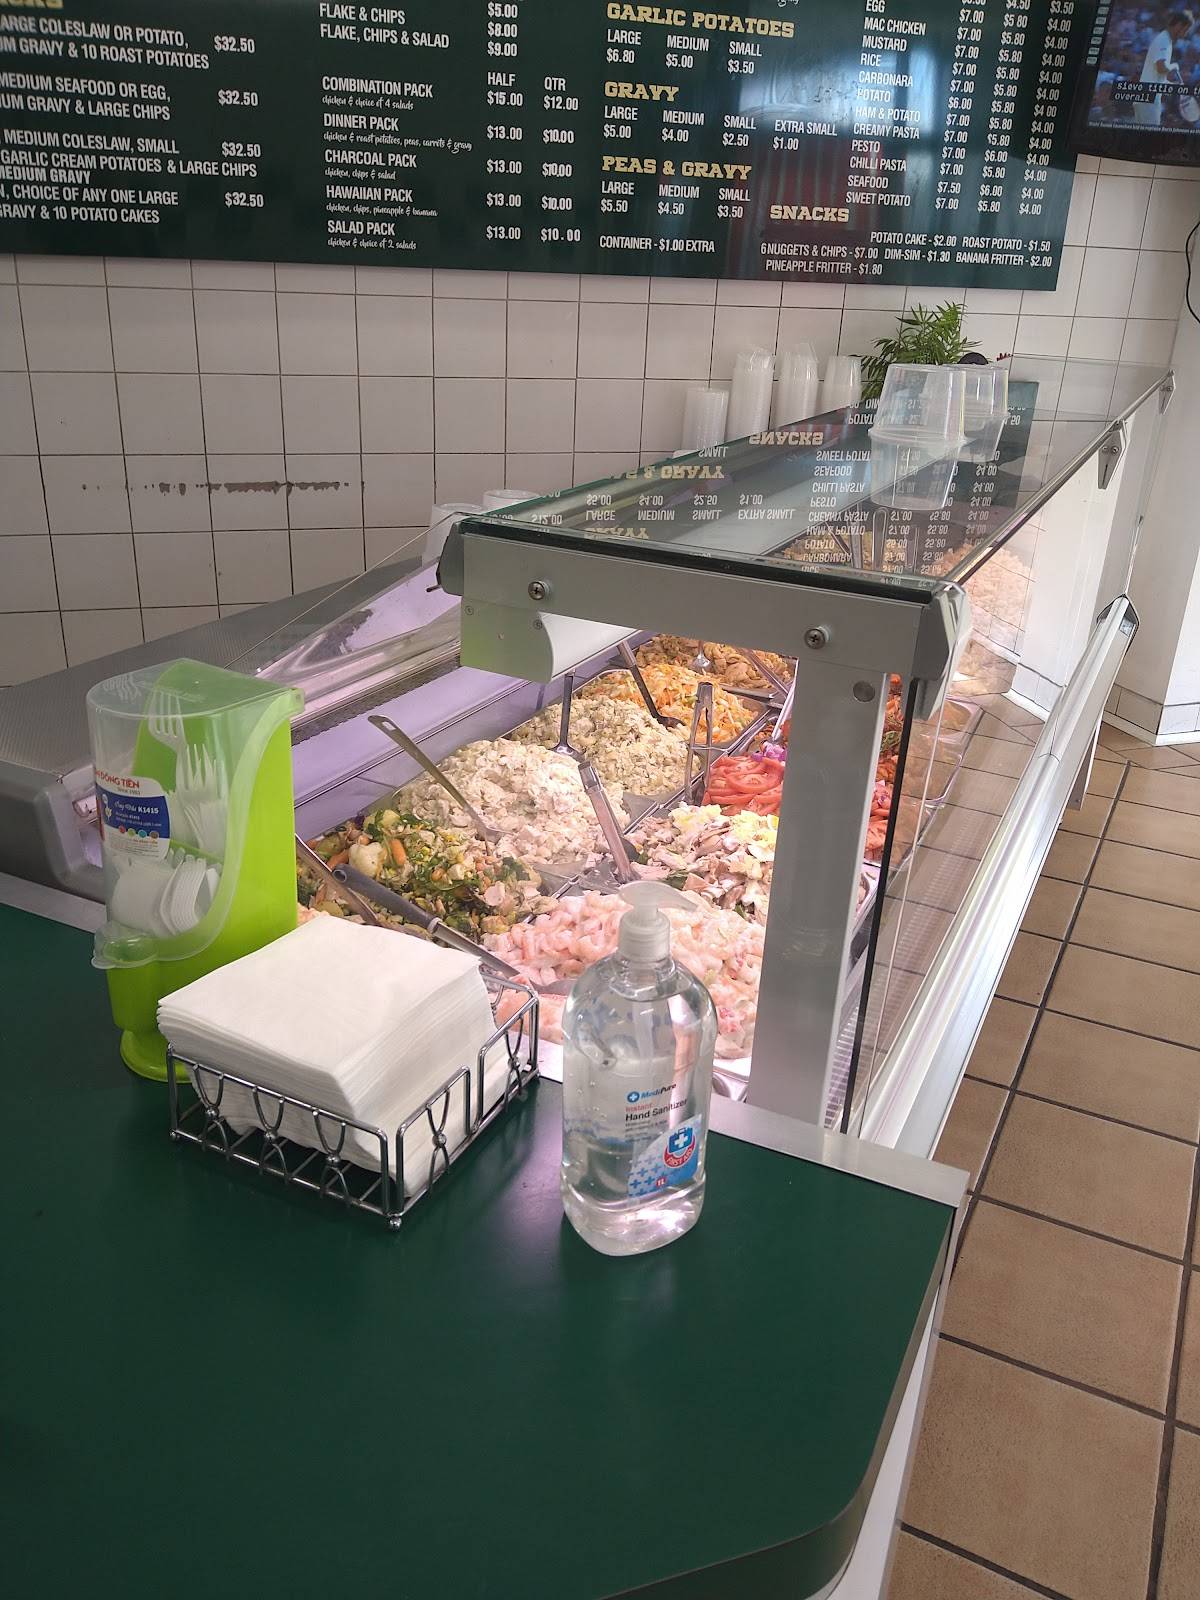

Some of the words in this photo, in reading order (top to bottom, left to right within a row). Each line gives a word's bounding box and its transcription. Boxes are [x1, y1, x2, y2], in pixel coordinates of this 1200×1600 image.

[319, 3, 356, 20] FLAKE
[371, 8, 405, 25] CHIPS
[487, 2, 518, 18] $5.00
[1050, 0, 1074, 14] $3.50
[607, 2, 686, 26] GARLIC
[691, 11, 795, 38] POTATOES
[959, 9, 984, 24] $7.00
[1047, 18, 1071, 32] $4.00
[39, 18, 110, 40] COLESLAW
[114, 25, 132, 41] OR
[136, 30, 189, 49] POTATO,
[487, 22, 518, 38] $8.00
[864, 17, 886, 32] MAC
[887, 20, 926, 36] CHICKEN
[214, 35, 255, 54] $32.50
[320, 24, 360, 43] FLAKE,
[363, 27, 398, 44] CHIPS
[412, 32, 449, 49] SALAD
[607, 28, 641, 46] LARGE
[667, 34, 709, 52] MEDIUM
[729, 41, 762, 57] SMALL
[862, 35, 907, 51] MUSTARD
[1000, 31, 1025, 45] $5.80
[19, 37, 63, 56] GRAVY
[81, 44, 97, 60] 10
[100, 46, 142, 64] ROAST
[147, 50, 209, 69] POTATOES
[487, 41, 518, 57] $9.00
[606, 48, 635, 65] $6.80
[665, 53, 694, 69] $5.00
[727, 58, 755, 75] $3.50
[860, 53, 881, 67] RICE
[55, 77, 116, 97] SEAFOOD
[119, 82, 137, 99] OR
[140, 84, 171, 102] EGG,
[322, 76, 401, 97] COMBINATION
[404, 82, 433, 98] PACK
[487, 72, 515, 87] HALF
[544, 77, 566, 92] QTR
[218, 89, 258, 107] $32.50
[604, 80, 679, 102] GRAVY
[27, 96, 70, 113] GRAVY
[88, 102, 131, 119] LARGE
[133, 105, 170, 120] CHIPS
[487, 91, 523, 107] $15.00
[543, 95, 579, 111] $12.00
[948, 96, 973, 111] $6.00
[324, 113, 367, 130] DINNER
[370, 116, 399, 132] PACK
[604, 105, 638, 121] LARGE
[663, 110, 704, 126] MEDIUM
[724, 114, 756, 130] SMALL
[487, 125, 523, 140] $13.00
[775, 119, 805, 134] EXTRA
[807, 121, 838, 137] SMALL
[853, 123, 891, 138] CREAMY
[893, 126, 920, 140] PASTA
[4, 129, 59, 147] MEDIUM
[62, 133, 134, 153] COLESLAW,
[137, 138, 180, 154] SMALL
[603, 124, 632, 139] $5.00
[661, 127, 689, 143] $4.00
[722, 132, 749, 147] $2.50
[773, 136, 799, 151] $1.00
[222, 142, 261, 158] $32.50
[851, 140, 880, 153] PESTO
[1, 149, 49, 167] GARLIC
[51, 153, 97, 170] CREAM
[100, 156, 162, 173] POTATOES
[179, 160, 219, 177] LARGE
[221, 162, 257, 178] CHIPS
[325, 149, 385, 166] CHARCOAL
[388, 153, 417, 168] PACK
[849, 157, 877, 170] CHILLI
[880, 158, 907, 172] PASTA
[984, 150, 1009, 164] $6.00
[486, 159, 522, 174] $13.00
[602, 155, 657, 175] PEAS
[681, 161, 752, 181] GRAVY
[50, 168, 91, 185] GRAVY
[847, 174, 888, 188] SEAFOOD
[12, 184, 60, 201] CHOICE
[62, 187, 79, 201] OF
[82, 188, 107, 203] ANY
[110, 190, 136, 204] ONE
[139, 191, 179, 206] LARGE
[326, 185, 382, 201] HAWAIIAN
[384, 187, 413, 203] PACK
[602, 180, 634, 196] LARGE
[658, 183, 699, 199] MEDIUM
[718, 187, 750, 202] SMALL
[937, 180, 962, 195] $7.50
[225, 192, 264, 208] $32.50
[486, 193, 522, 208] $13.00
[846, 191, 876, 205] SWEET
[878, 192, 911, 207] POTATO
[53, 206, 68, 221] 10
[71, 207, 117, 222] POTATO
[120, 208, 160, 224] CAKES
[601, 199, 628, 213] $5.50
[657, 202, 685, 216] $4.50
[717, 204, 743, 219] $3.50
[770, 204, 849, 223] SNACKS
[328, 220, 364, 235] SALAD
[367, 222, 395, 237] PACK
[486, 225, 521, 241] $13.00
[600, 235, 652, 250] CONTAINER
[659, 238, 684, 252] $1.00
[685, 238, 715, 253] EXTRA
[870, 231, 904, 246] POTATO
[904, 233, 927, 246] CAKE
[933, 234, 957, 248] $2.00
[962, 237, 989, 250] ROAST
[991, 237, 1022, 251] POTATO
[1028, 239, 1051, 252] $1.50
[820, 243, 848, 258] CHIPS
[854, 246, 879, 260] $7.00
[884, 247, 921, 261] DIM-SIM
[926, 250, 950, 263] $1.30
[956, 251, 989, 264] BANANA
[991, 253, 1024, 267] FRITTER
[1030, 255, 1052, 267] $2.00
[766, 259, 814, 273] PINEAPPLE
[816, 261, 850, 275] FRITTER
[858, 262, 883, 276] $1.80
[138, 806, 159, 814] K1415
[641, 1083, 676, 1099] MediPure
[625, 1111, 650, 1121] Hand
[652, 1099, 687, 1116] Sanitizer
